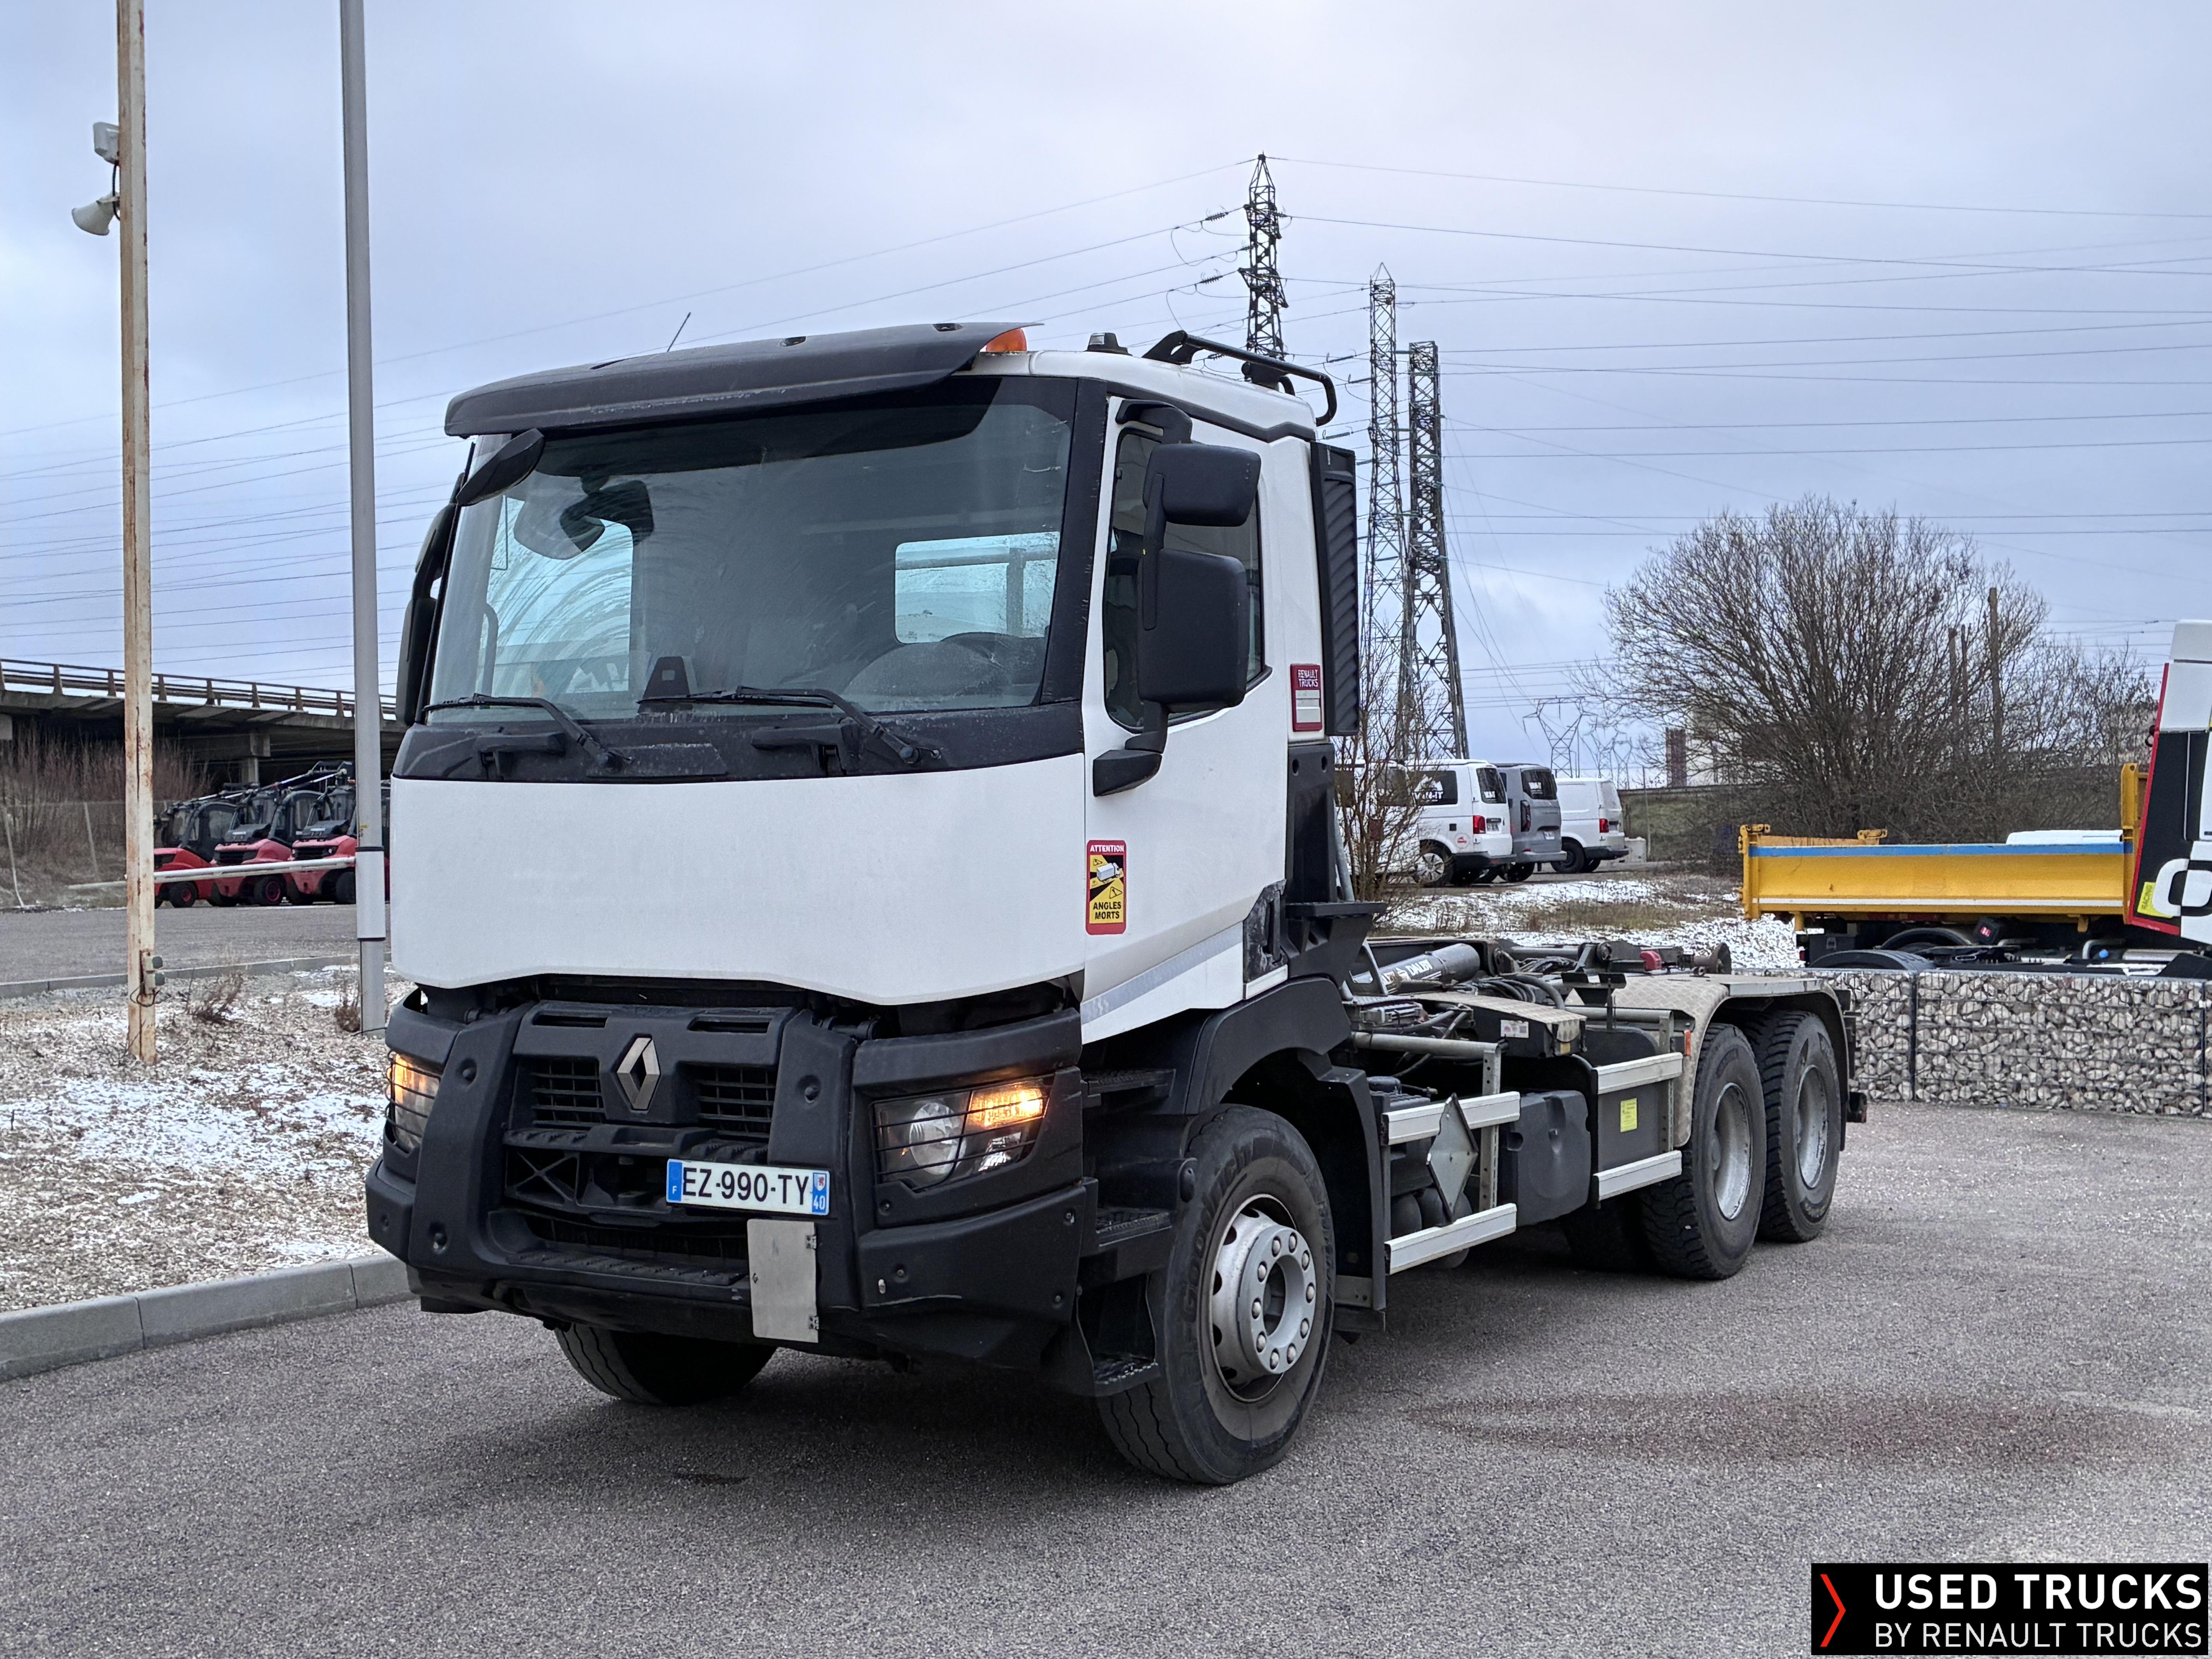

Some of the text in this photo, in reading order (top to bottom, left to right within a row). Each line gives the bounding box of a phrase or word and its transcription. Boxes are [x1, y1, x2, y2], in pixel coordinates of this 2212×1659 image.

[1298, 679, 1318, 687] TRUCKS
[1093, 902, 1121, 910] ANGLES
[1095, 911, 1120, 920] MORTS
[1405, 959, 1433, 976] DALBY
[672, 1167, 826, 1210] F EZ-990-TY 40
